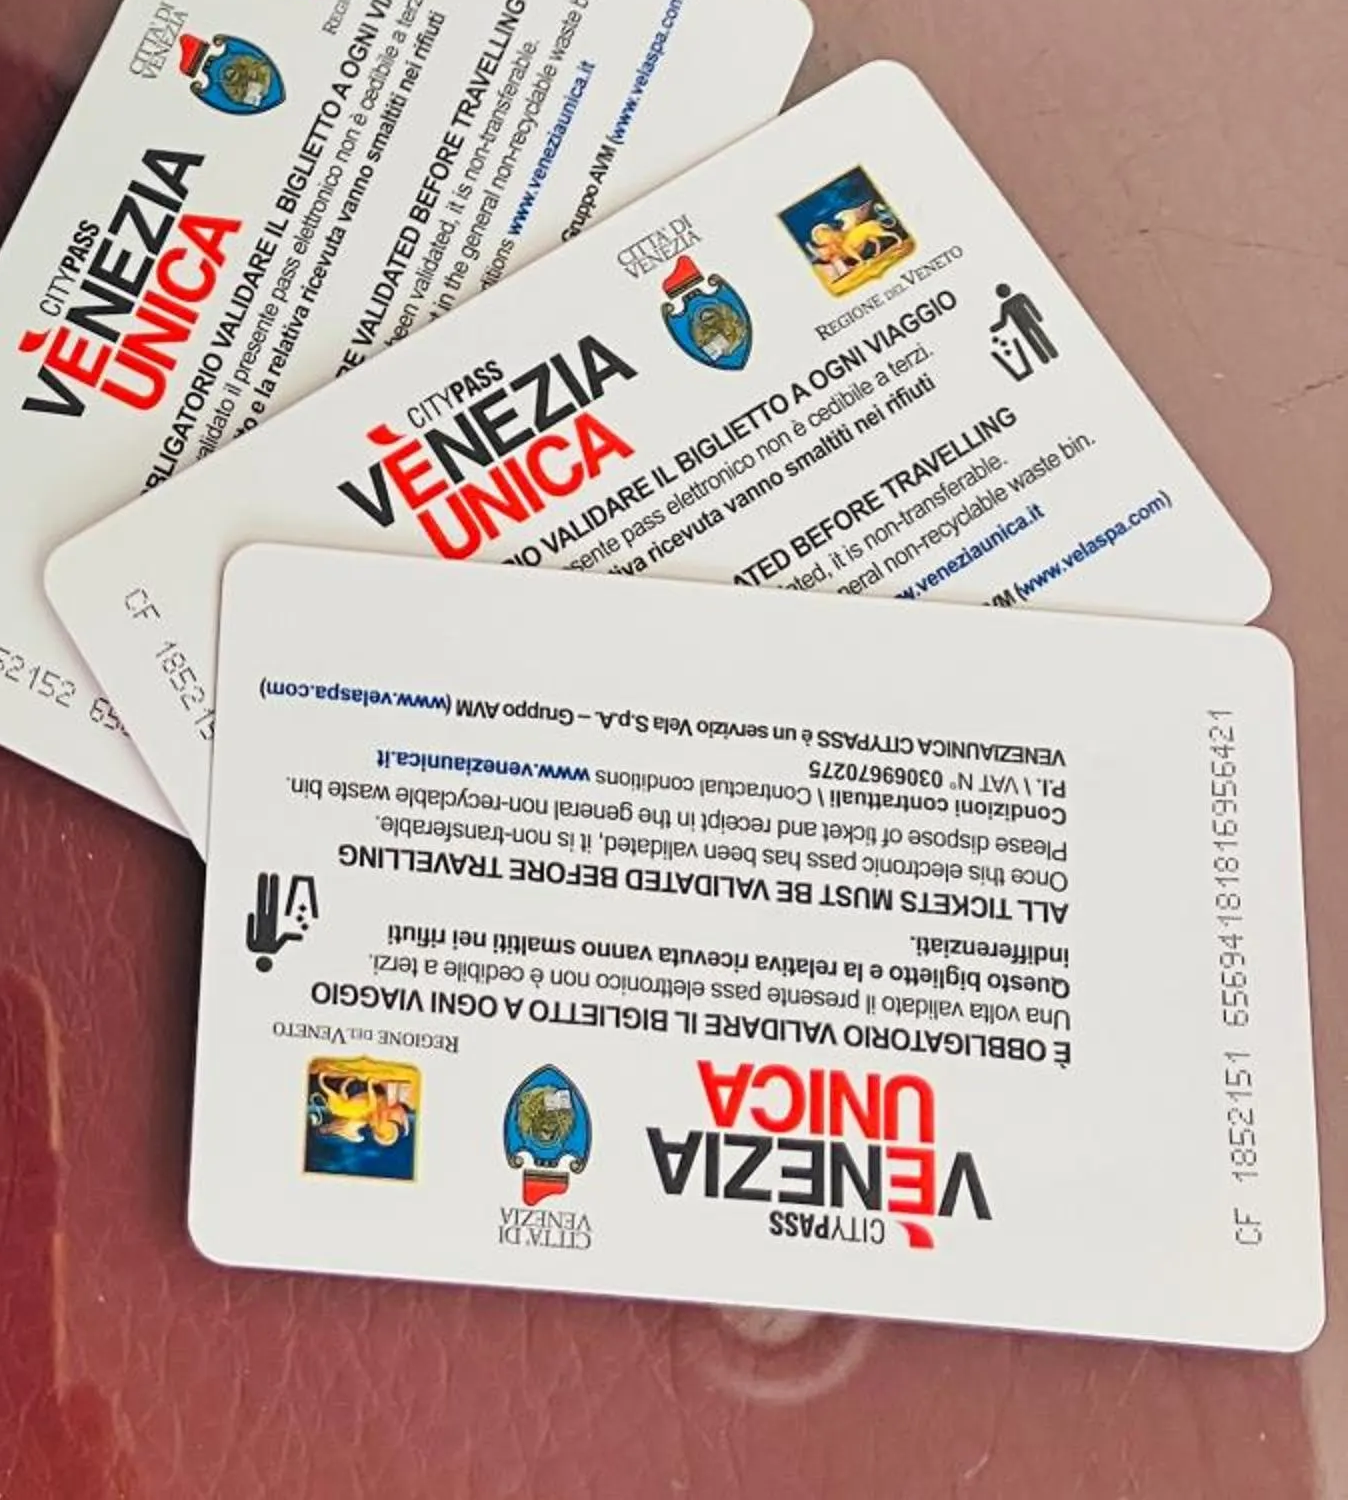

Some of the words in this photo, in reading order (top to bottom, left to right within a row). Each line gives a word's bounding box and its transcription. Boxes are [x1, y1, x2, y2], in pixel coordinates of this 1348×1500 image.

[140, 11, 189, 80] VENEZIA
[413, 9, 446, 61] rifiuti
[339, 21, 379, 79] OGNI
[398, 59, 423, 93] nei
[331, 83, 353, 102] A
[365, 91, 409, 164] smaltiti
[274, 99, 342, 215] BIGLIETTO
[507, 59, 596, 236] www.veneziaunica.it
[336, 164, 375, 223] vanno
[263, 218, 290, 239] IL
[350, 225, 421, 346] VALIDATED
[407, 129, 466, 225] BEFORE
[39, 219, 101, 317] CITYPASS
[299, 225, 348, 304] ricevuta
[209, 236, 279, 348] VALIDARE
[100, 214, 242, 411] UNICA
[267, 304, 311, 378] relativa
[253, 378, 278, 399] la
[406, 359, 505, 429] CITYPASS
[250, 400, 266, 415] e
[137, 352, 224, 497] BLIGATORIO
[539, 475, 656, 555] VALIDARE
[650, 465, 679, 489] IL
[673, 393, 790, 475] BIGLIETTO
[790, 382, 813, 405] A
[807, 344, 868, 391] OGNI
[861, 289, 957, 355] VIAGGIO
[418, 412, 634, 560] UNICA
[788, 488, 886, 559] BEFORE
[879, 406, 1018, 499] TRAVELLING
[1013, 489, 1173, 603] (www.velaspa.com)
[259, 676, 453, 717] (www.velaspa.com)
[455, 698, 501, 720] AVM
[501, 699, 575, 727] Gruppo
[594, 709, 650, 733] S.p.A.
[652, 715, 694, 737] Vela
[695, 719, 770, 741] servizio
[772, 725, 797, 741] un
[801, 728, 814, 748] è
[816, 729, 915, 755] CITYPASS
[916, 737, 1067, 768] VENEZIAUNICA
[376, 749, 591, 783] www.veneziaunica.it
[808, 759, 944, 789] 03069670275
[285, 776, 323, 801] bin.
[327, 780, 391, 802] waste
[594, 769, 695, 793] conditions
[699, 778, 813, 806] Contractual
[978, 774, 1019, 795] VAT
[1036, 777, 1067, 799] P.I.
[394, 786, 549, 816] non-recyclable
[553, 799, 634, 823] general
[829, 789, 949, 813] contrattuali
[954, 799, 1067, 827] Condizioni
[375, 815, 552, 847] non-transferable.
[637, 807, 672, 830] the
[676, 810, 696, 832] in
[700, 808, 772, 835] receipt
[776, 818, 818, 839] and
[557, 830, 575, 853] is
[579, 832, 592, 855] it
[599, 831, 699, 861] validated,
[821, 821, 878, 847] ticket
[880, 827, 904, 848] of
[907, 828, 991, 856] dispose
[337, 843, 504, 880] TRAVELLING
[703, 843, 757, 869] been
[761, 847, 802, 872] has
[806, 850, 858, 872] pass
[994, 836, 1068, 863] Please
[508, 857, 619, 889] BEFORE
[861, 855, 964, 884] electronic
[967, 864, 1006, 888] this
[1010, 867, 1069, 893] Once
[625, 868, 771, 902] VALIDATED
[775, 880, 813, 905] BE
[818, 883, 893, 912] MUST
[899, 890, 1013, 921] TICKETS
[1016, 899, 1070, 925] ALL
[387, 924, 447, 949] rifiuti
[452, 929, 487, 951] nei
[492, 932, 577, 957] smaltiti
[580, 940, 654, 962] vanno
[658, 946, 749, 974] ricevuta
[909, 935, 1069, 969] indifferenziati.
[368, 953, 419, 979] terzi.
[423, 958, 439, 976] a
[443, 959, 525, 985] cedibile
[529, 967, 545, 990] è
[549, 968, 591, 989] non
[754, 954, 838, 980] relativa
[843, 961, 864, 984] la
[869, 963, 884, 980] e
[888, 964, 981, 993] biglietto
[310, 981, 425, 1013] VIAGGIO
[595, 972, 706, 1002] elettronico
[710, 980, 762, 1002] pass
[766, 986, 861, 1010] presente
[986, 972, 1071, 1000] Questo
[430, 990, 499, 1019] OGNI
[503, 996, 525, 1021] A
[528, 999, 669, 1033] BIGLIETTO
[865, 994, 877, 1015] il
[881, 995, 965, 1021] validato
[969, 1001, 1021, 1025] volta
[674, 1010, 698, 1035] IL
[703, 1013, 838, 1046] VALIDARE
[1025, 1006, 1071, 1032] Una
[272, 1021, 346, 1045] VENETO
[377, 1029, 460, 1055] REGIONE
[843, 1024, 1047, 1063] OBBLIGATORIO
[1052, 1040, 1072, 1069] È
[698, 1060, 934, 1144] UNICA
[1223, 1050, 1258, 1182] 1852151
[499, 1206, 592, 1231] VENEZIA
[769, 1209, 886, 1245] CITYPASS
[1235, 1207, 1262, 1246] CF
[498, 1225, 522, 1246] DI
